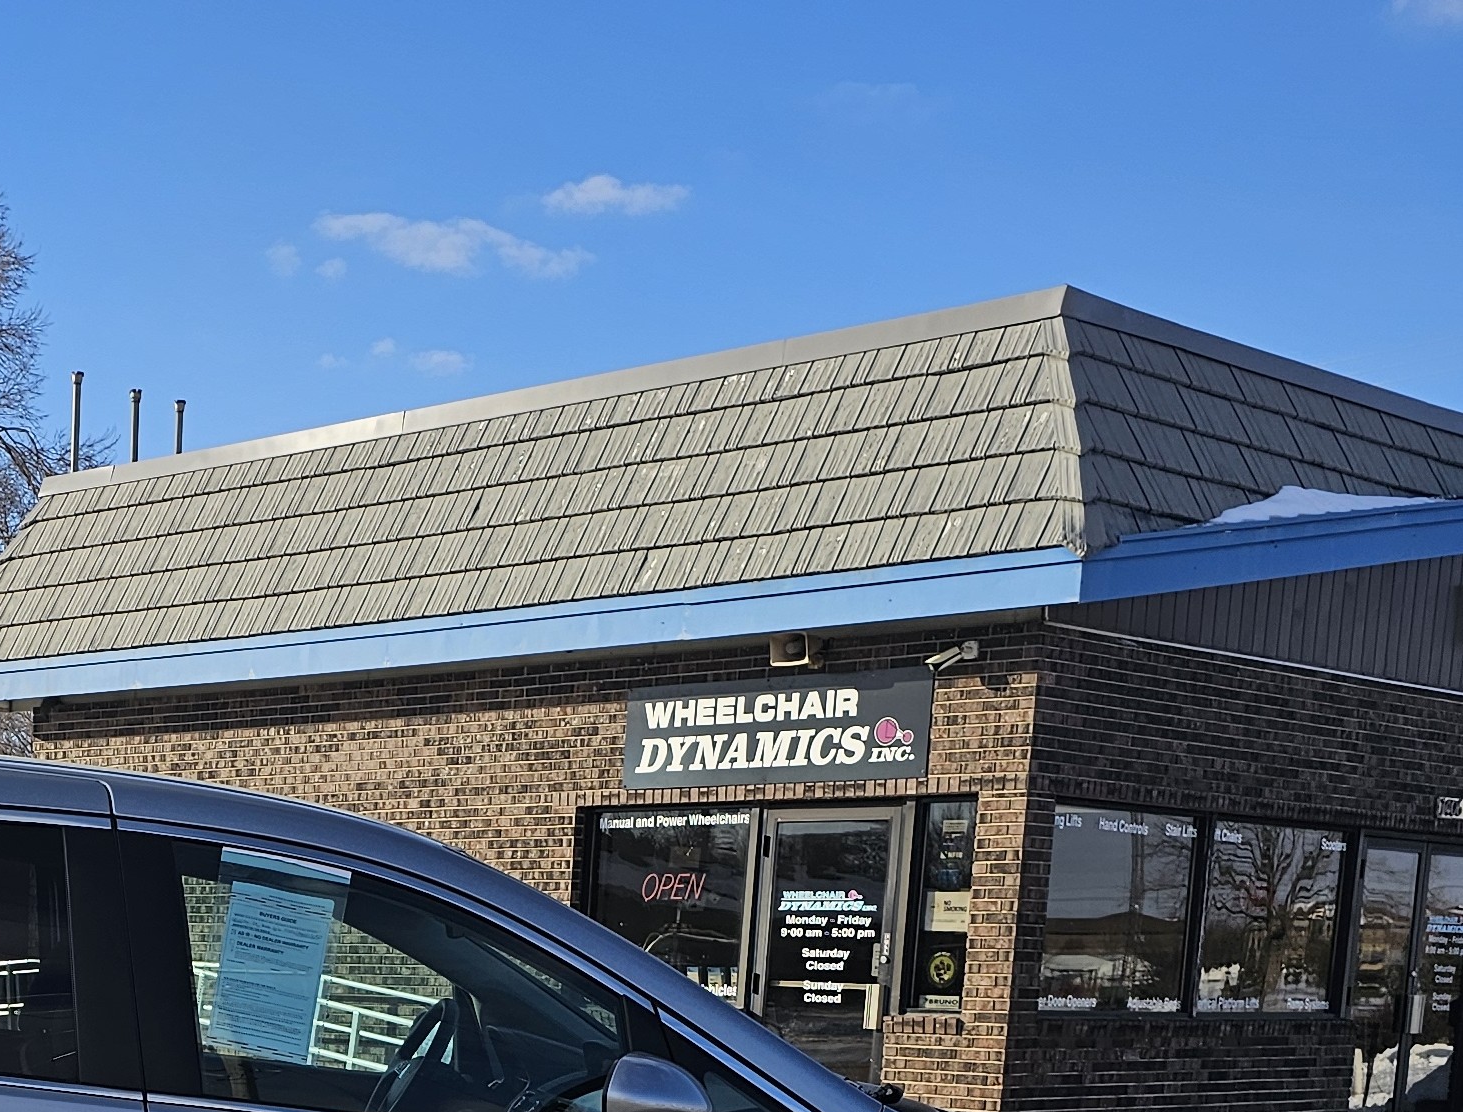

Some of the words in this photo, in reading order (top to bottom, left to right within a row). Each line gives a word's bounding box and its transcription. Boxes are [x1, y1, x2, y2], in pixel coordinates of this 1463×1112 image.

[645, 688, 859, 729] WHEELCHAIR
[635, 725, 870, 774] DYNAMICS
[868, 746, 915, 763] INC.
[600, 816, 633, 830] Manual
[636, 816, 654, 828] and
[656, 815, 687, 827] Power
[689, 812, 750, 826] Wheelchairs
[1066, 813, 1082, 827] Lifts
[1099, 816, 1118, 831] Hand
[1119, 820, 1149, 835] Controls
[1165, 823, 1182, 836] Stair
[1182, 824, 1198, 838] Lifts
[1222, 829, 1243, 843] Chairs
[1321, 837, 1347, 851] Scooters
[642, 873, 706, 902] OPEN
[782, 890, 846, 899] WHEELCHAIR
[778, 901, 865, 911] DYNAMICS
[259, 911, 280, 921] BUYERS
[785, 915, 829, 926] Monday
[837, 915, 872, 927] Friday
[780, 928, 803, 937] 9:00
[805, 929, 823, 937] am
[831, 928, 855, 937] 5:00
[856, 929, 876, 939] pm
[801, 948, 850, 960] Saturday
[806, 961, 844, 970] Closed
[803, 980, 843, 992] Sunday
[804, 993, 842, 1003] Closed
[1048, 995, 1066, 1007] Door
[1067, 995, 1097, 1009] Openers
